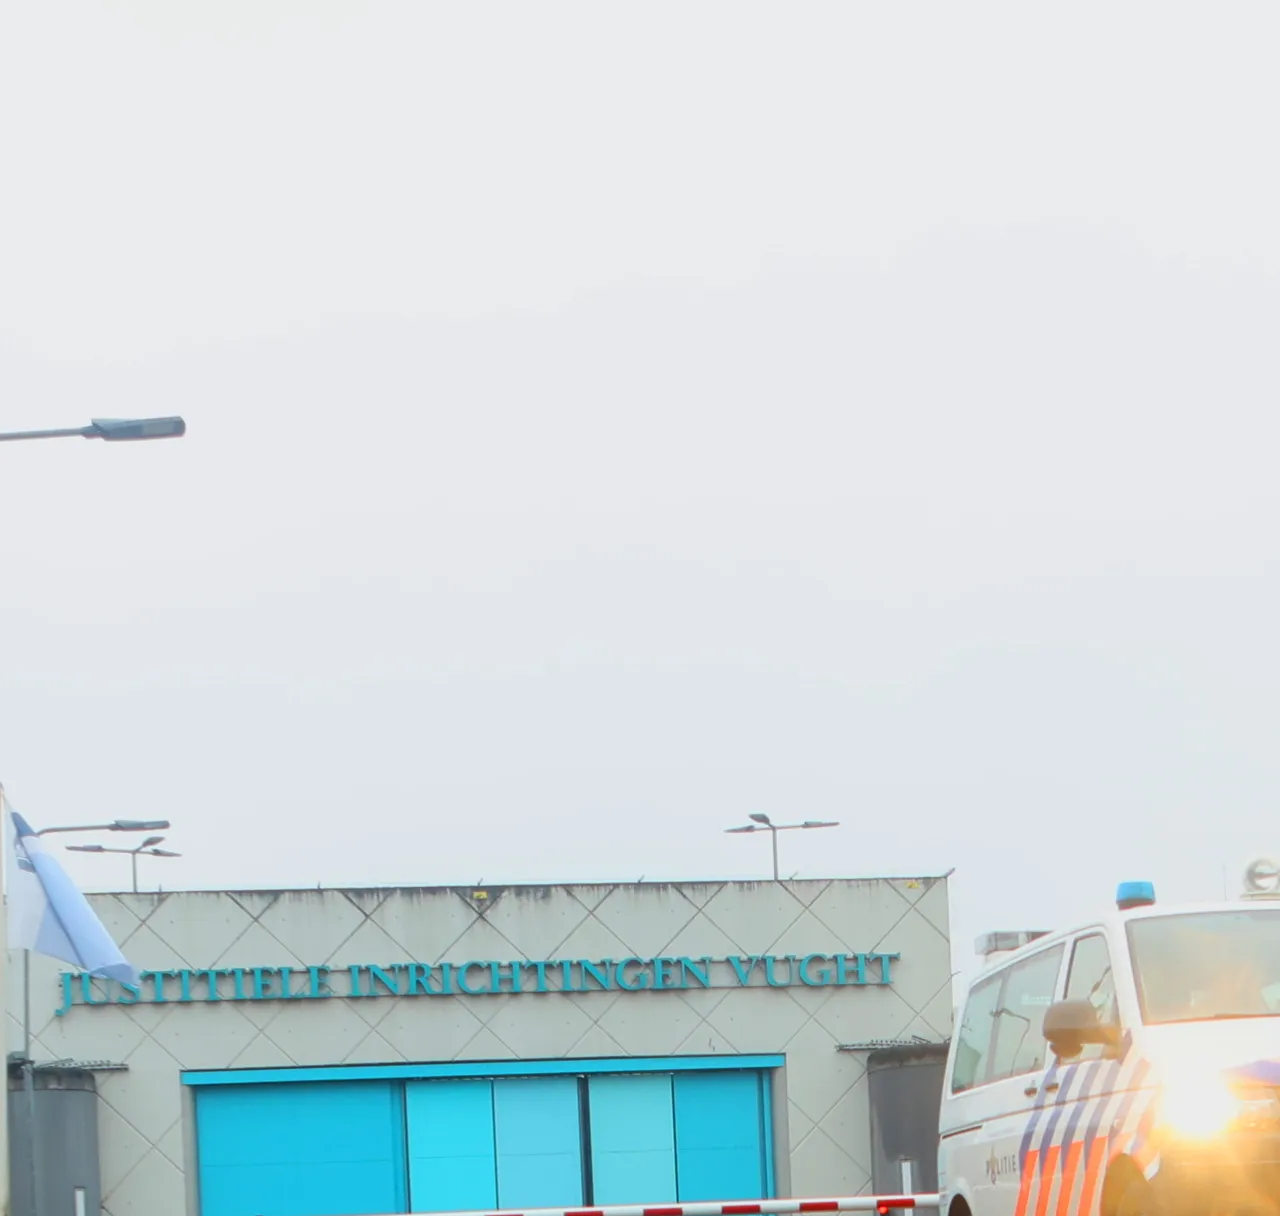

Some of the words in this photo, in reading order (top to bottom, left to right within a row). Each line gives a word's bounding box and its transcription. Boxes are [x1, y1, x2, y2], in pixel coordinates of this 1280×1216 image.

[55, 964, 332, 1016] JUSTITIELE
[348, 957, 711, 996] INRICHTINGEN
[728, 951, 901, 988] VUGHT
